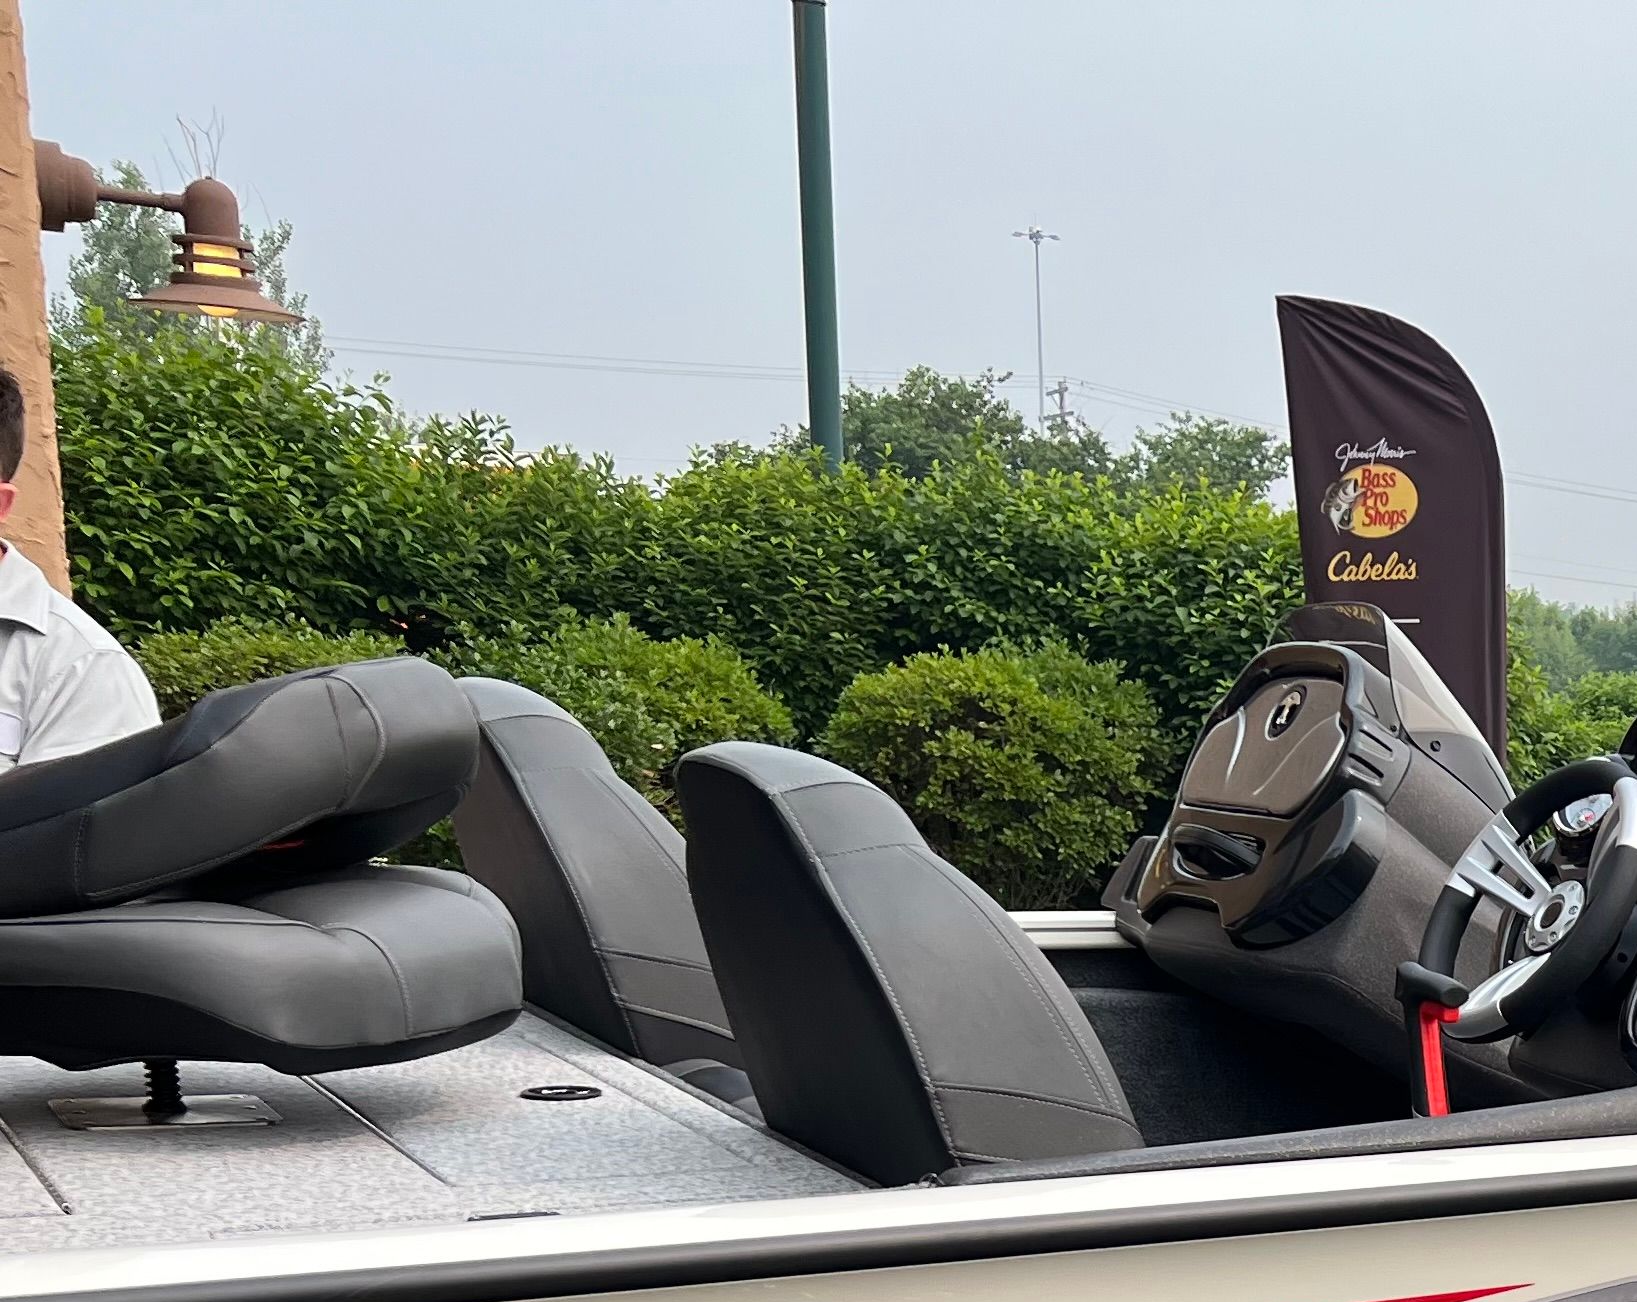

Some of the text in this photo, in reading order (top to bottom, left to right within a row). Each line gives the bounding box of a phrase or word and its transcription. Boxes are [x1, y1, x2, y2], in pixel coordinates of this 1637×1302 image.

[1360, 467, 1396, 488] Bass
[1361, 488, 1389, 507] Pro
[1361, 506, 1408, 530] Shops
[1327, 550, 1418, 582] Cabela's
